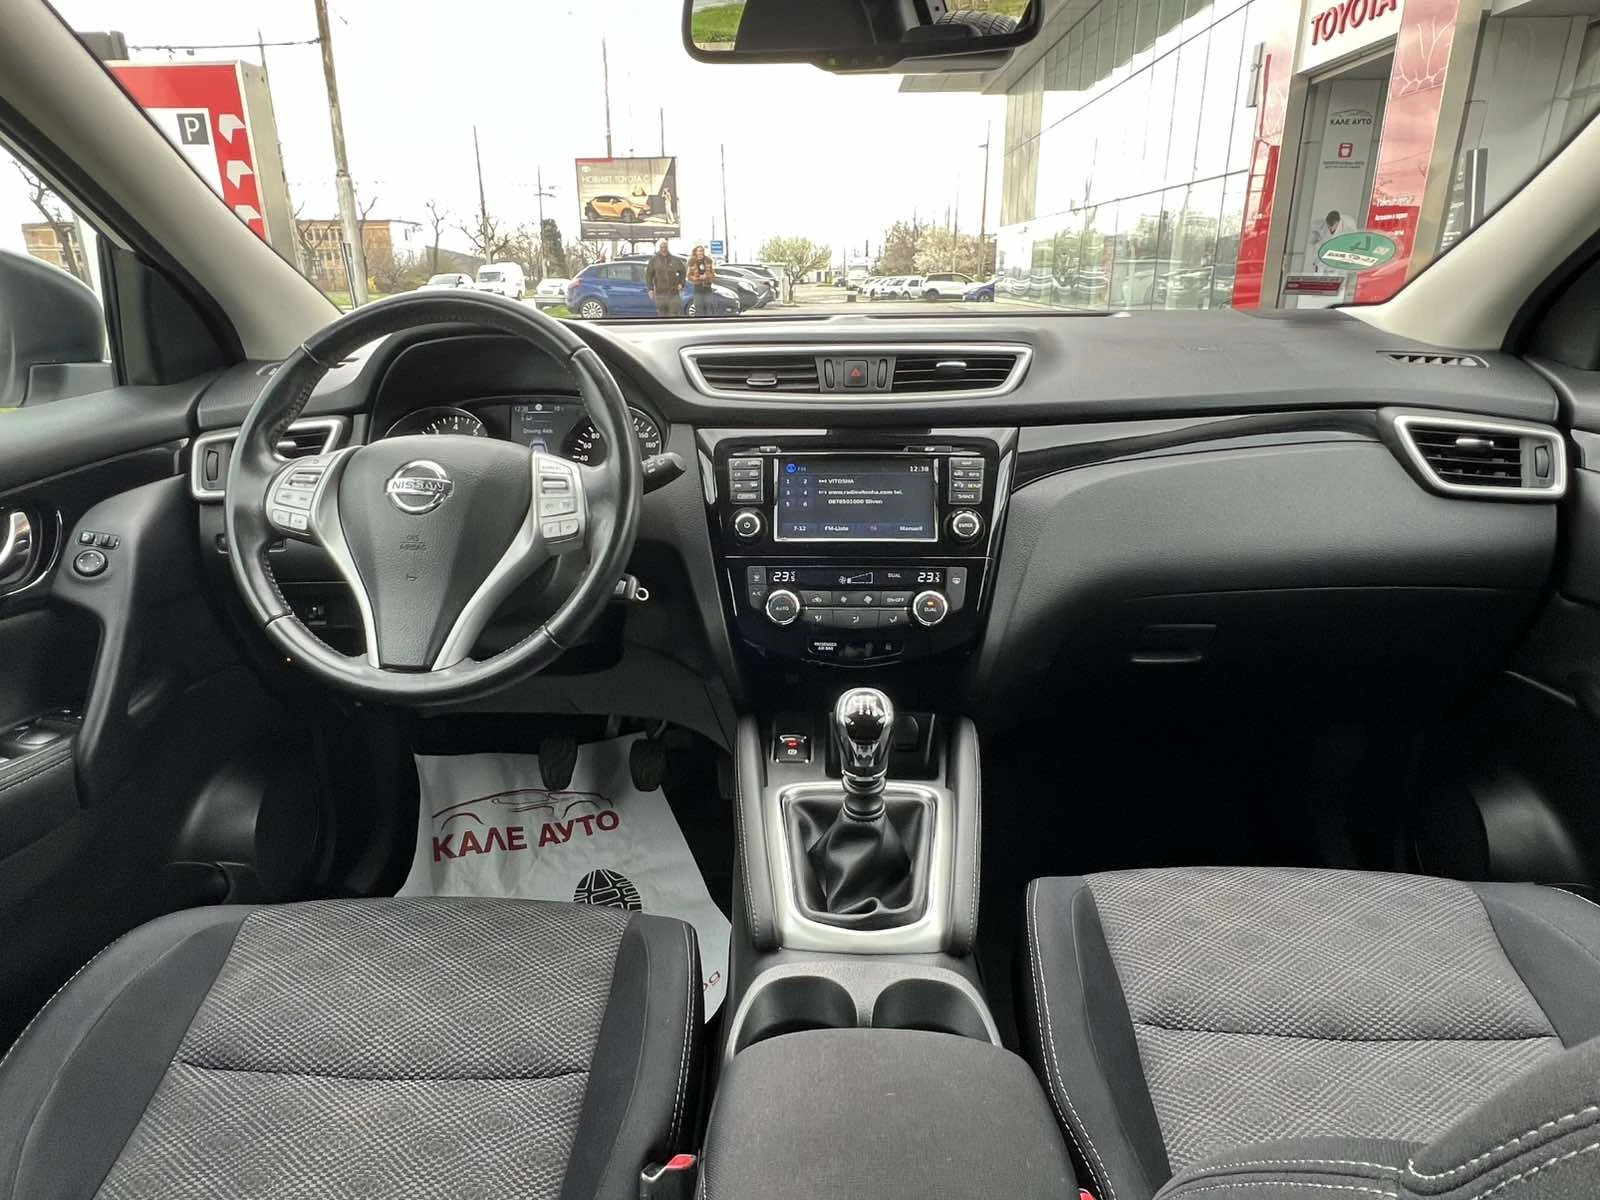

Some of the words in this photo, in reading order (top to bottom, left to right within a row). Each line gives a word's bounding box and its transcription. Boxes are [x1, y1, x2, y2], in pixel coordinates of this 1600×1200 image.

[184, 117, 200, 141] P
[392, 480, 445, 492] NISSAN
[432, 826, 527, 863] КАЛЕ
[538, 810, 620, 848] АУТО
